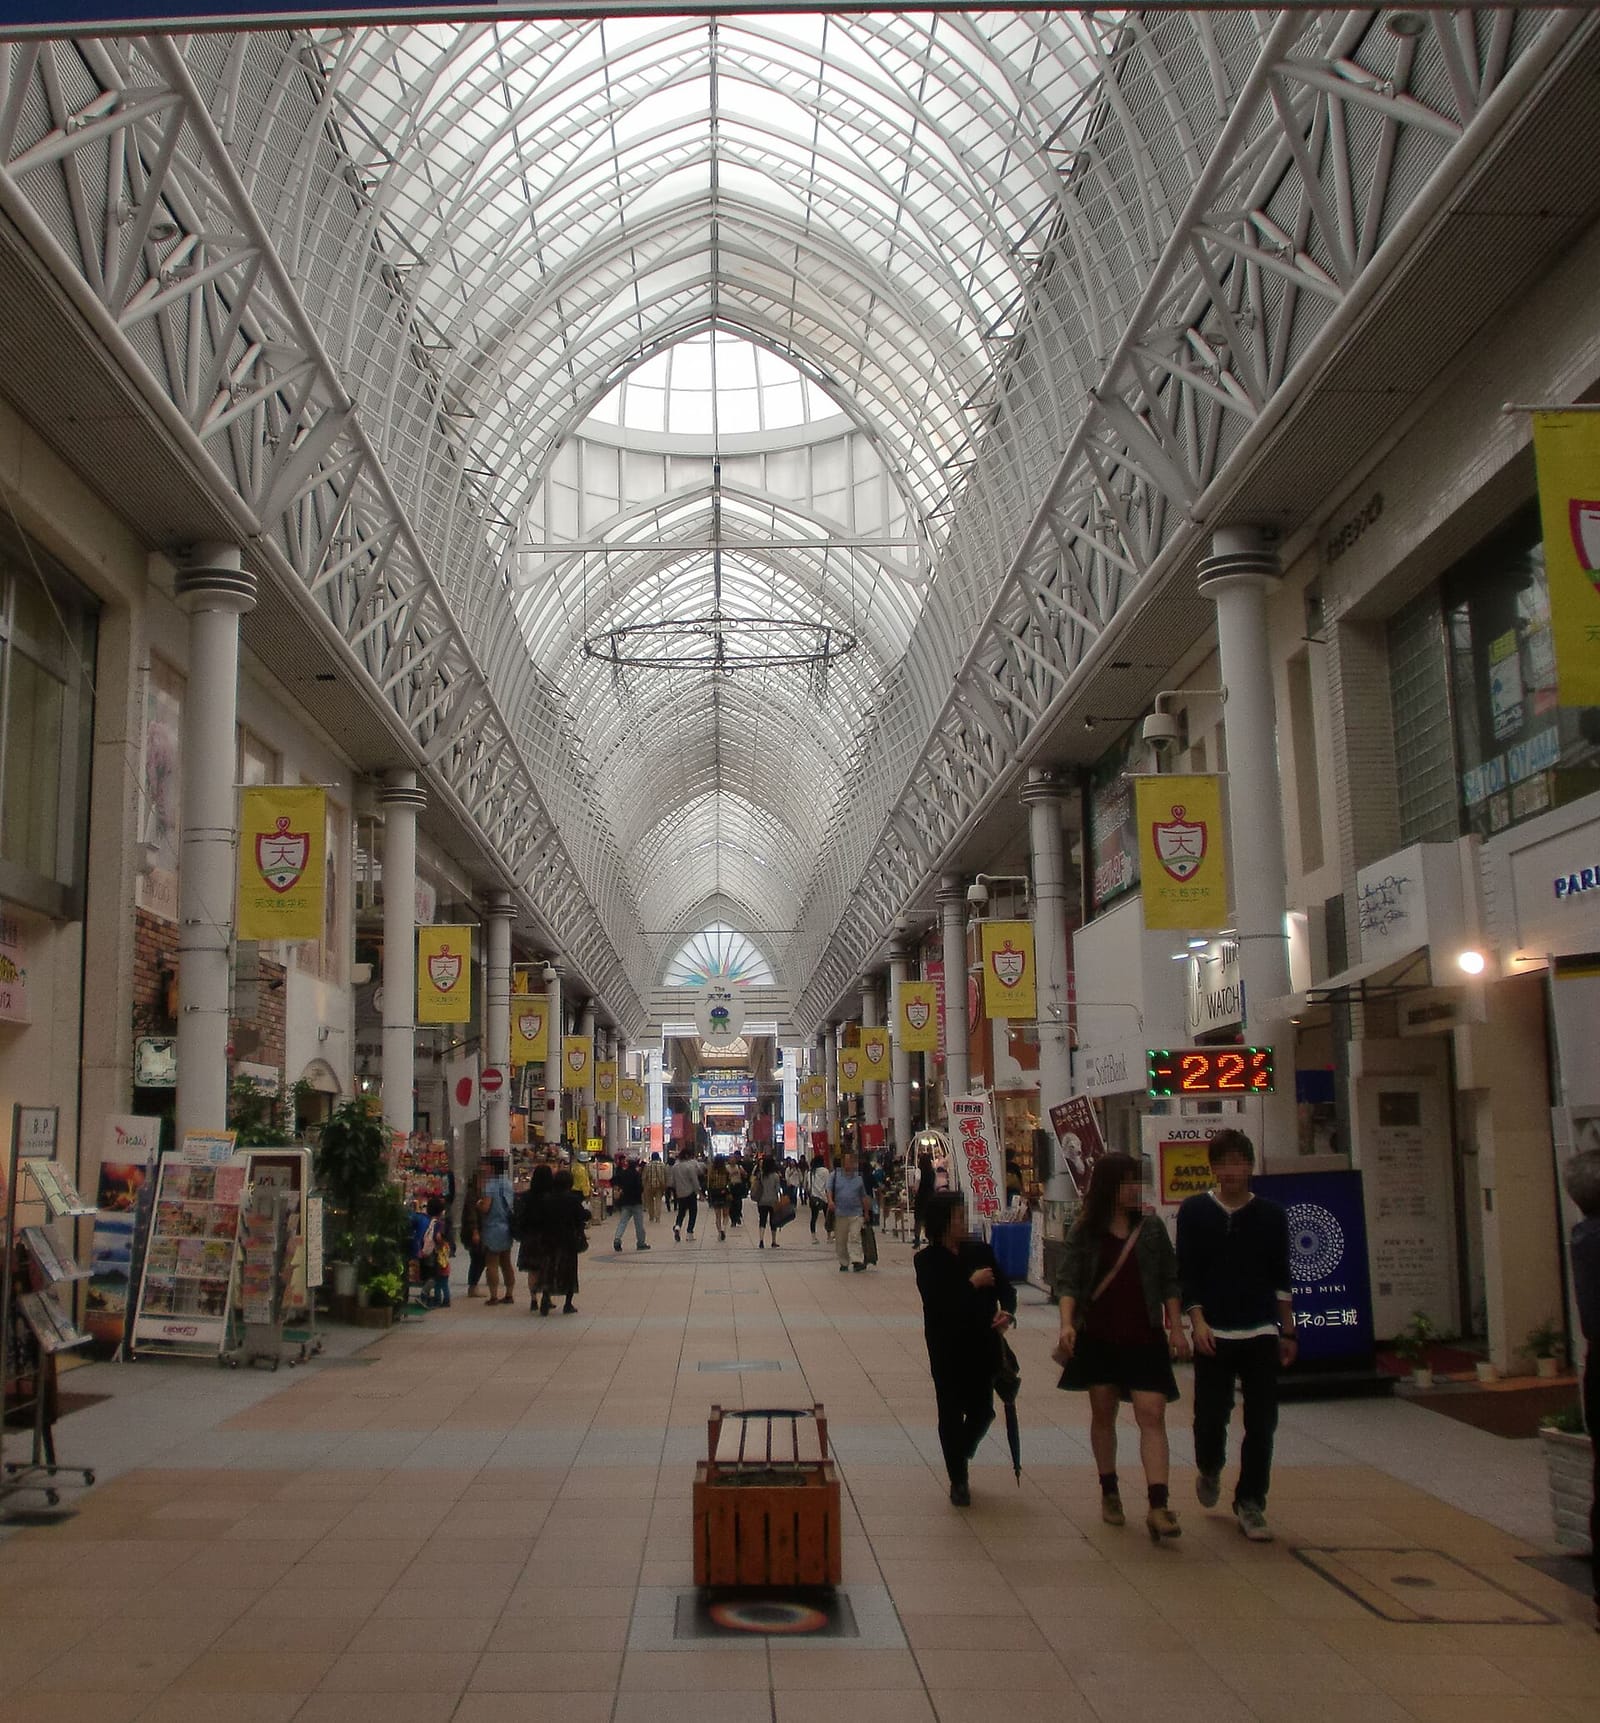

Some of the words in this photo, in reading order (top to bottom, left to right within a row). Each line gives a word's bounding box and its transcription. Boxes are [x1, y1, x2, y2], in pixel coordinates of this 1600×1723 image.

[1207, 984, 1240, 1020] WATCH
[1168, 1129, 1201, 1140] SATOL
[1319, 1285, 1346, 1293] MIKI
